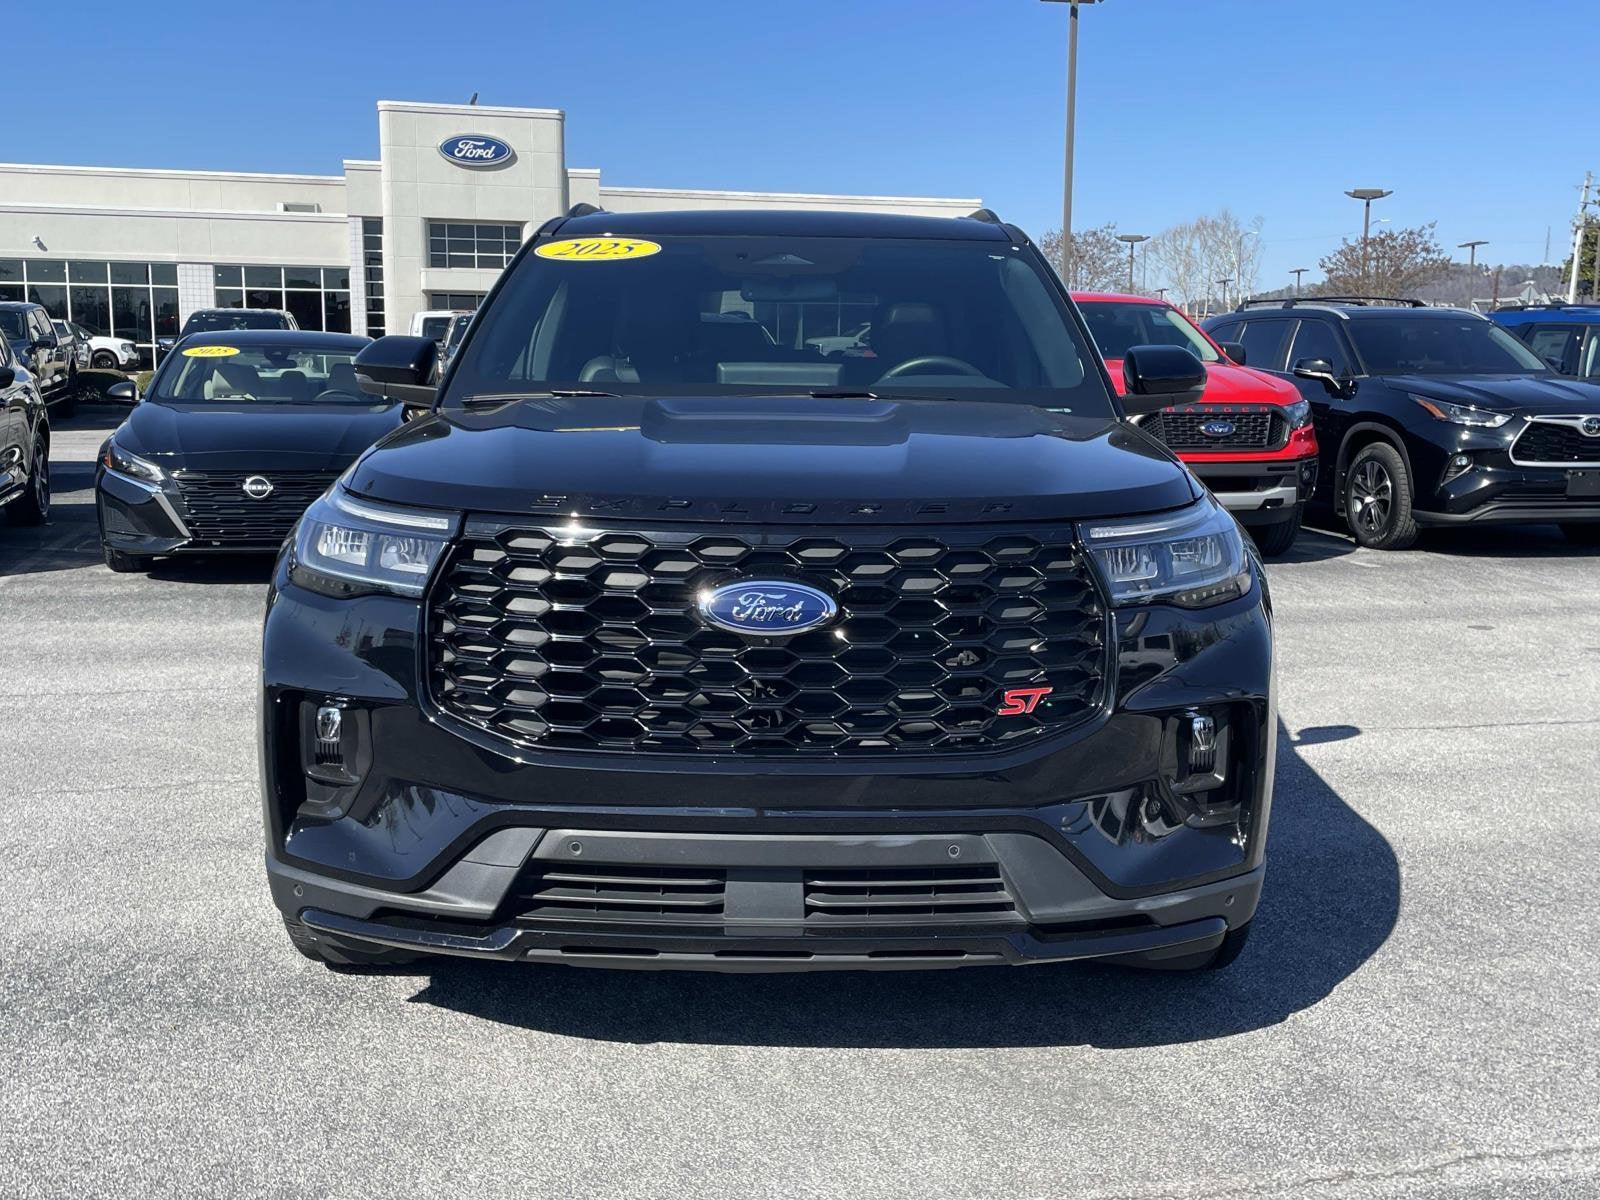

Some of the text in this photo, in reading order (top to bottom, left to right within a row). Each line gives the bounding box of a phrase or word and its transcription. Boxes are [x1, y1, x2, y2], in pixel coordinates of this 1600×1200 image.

[454, 139, 496, 159] Ford
[553, 242, 643, 256] 2025
[530, 494, 1014, 516] EXPLORER
[732, 592, 805, 622] Ford
[997, 686, 1054, 716] ST
